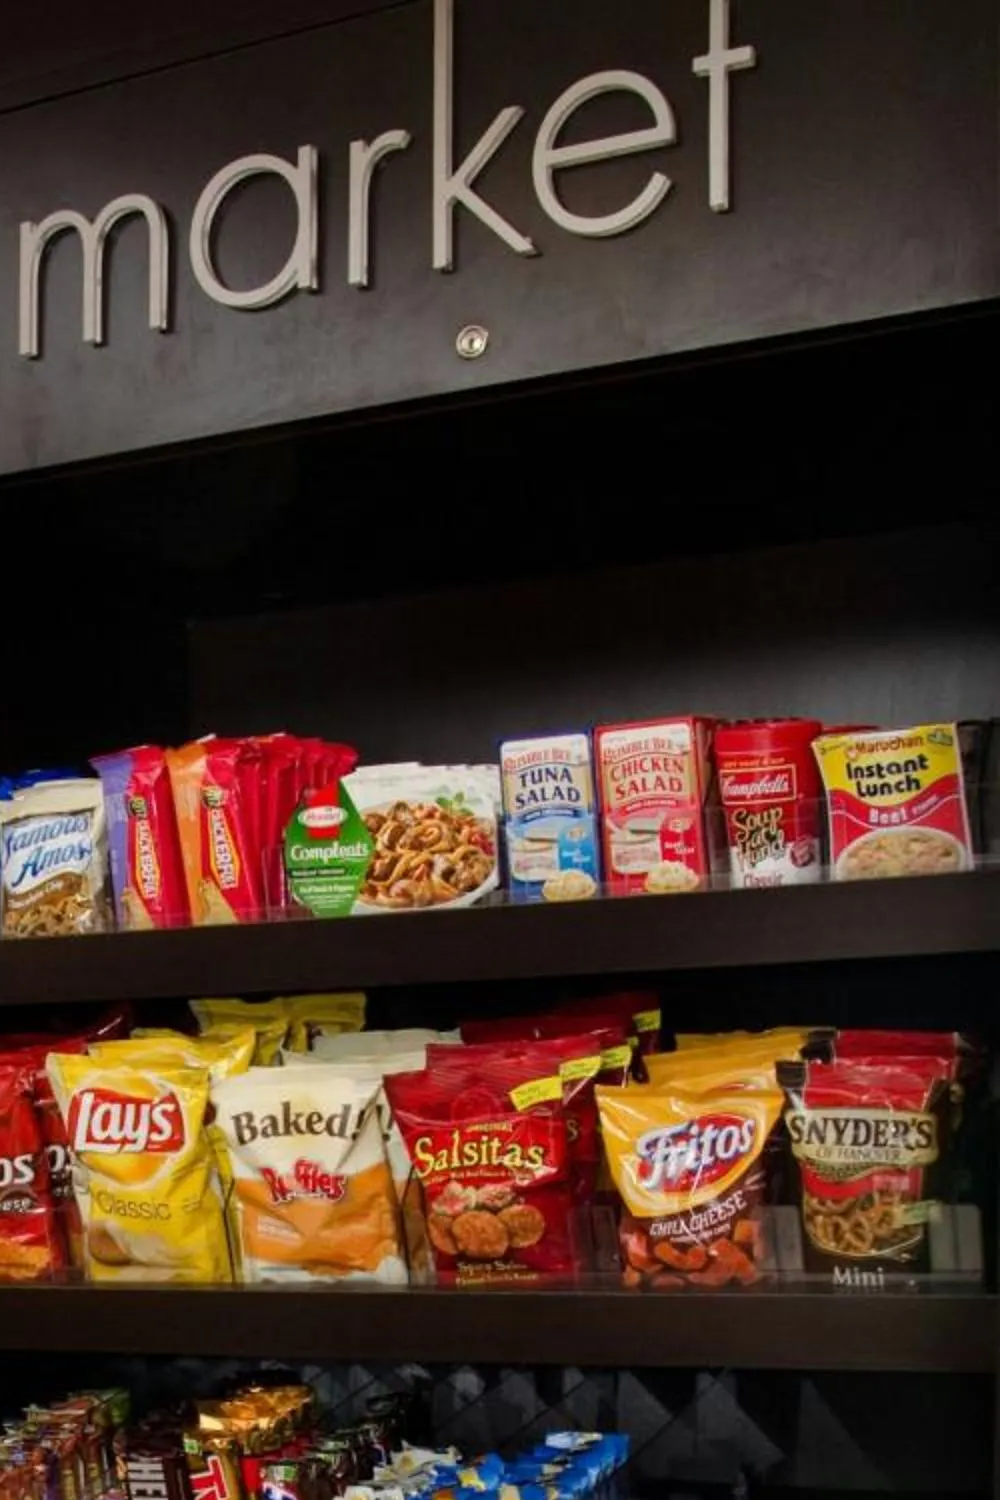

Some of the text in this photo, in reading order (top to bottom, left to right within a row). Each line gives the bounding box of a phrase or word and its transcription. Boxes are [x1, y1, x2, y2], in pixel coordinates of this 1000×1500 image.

[18, 0, 756, 362] market
[519, 766, 573, 788] TUNA
[610, 755, 685, 783] CHICKEN
[846, 753, 930, 780] Instant
[515, 785, 581, 810] SALAD
[615, 777, 683, 800] SALAD
[856, 775, 921, 798] Lunch
[732, 807, 783, 834] Soup
[21, 843, 92, 888] Amos
[789, 1114, 934, 1151] SNYDER'S
[414, 1128, 545, 1178] Salsitas
[636, 1119, 756, 1189] Fritos
[96, 1190, 173, 1221] Classic
[689, 1190, 748, 1232] CHEESE
[831, 1265, 885, 1287] Mini
